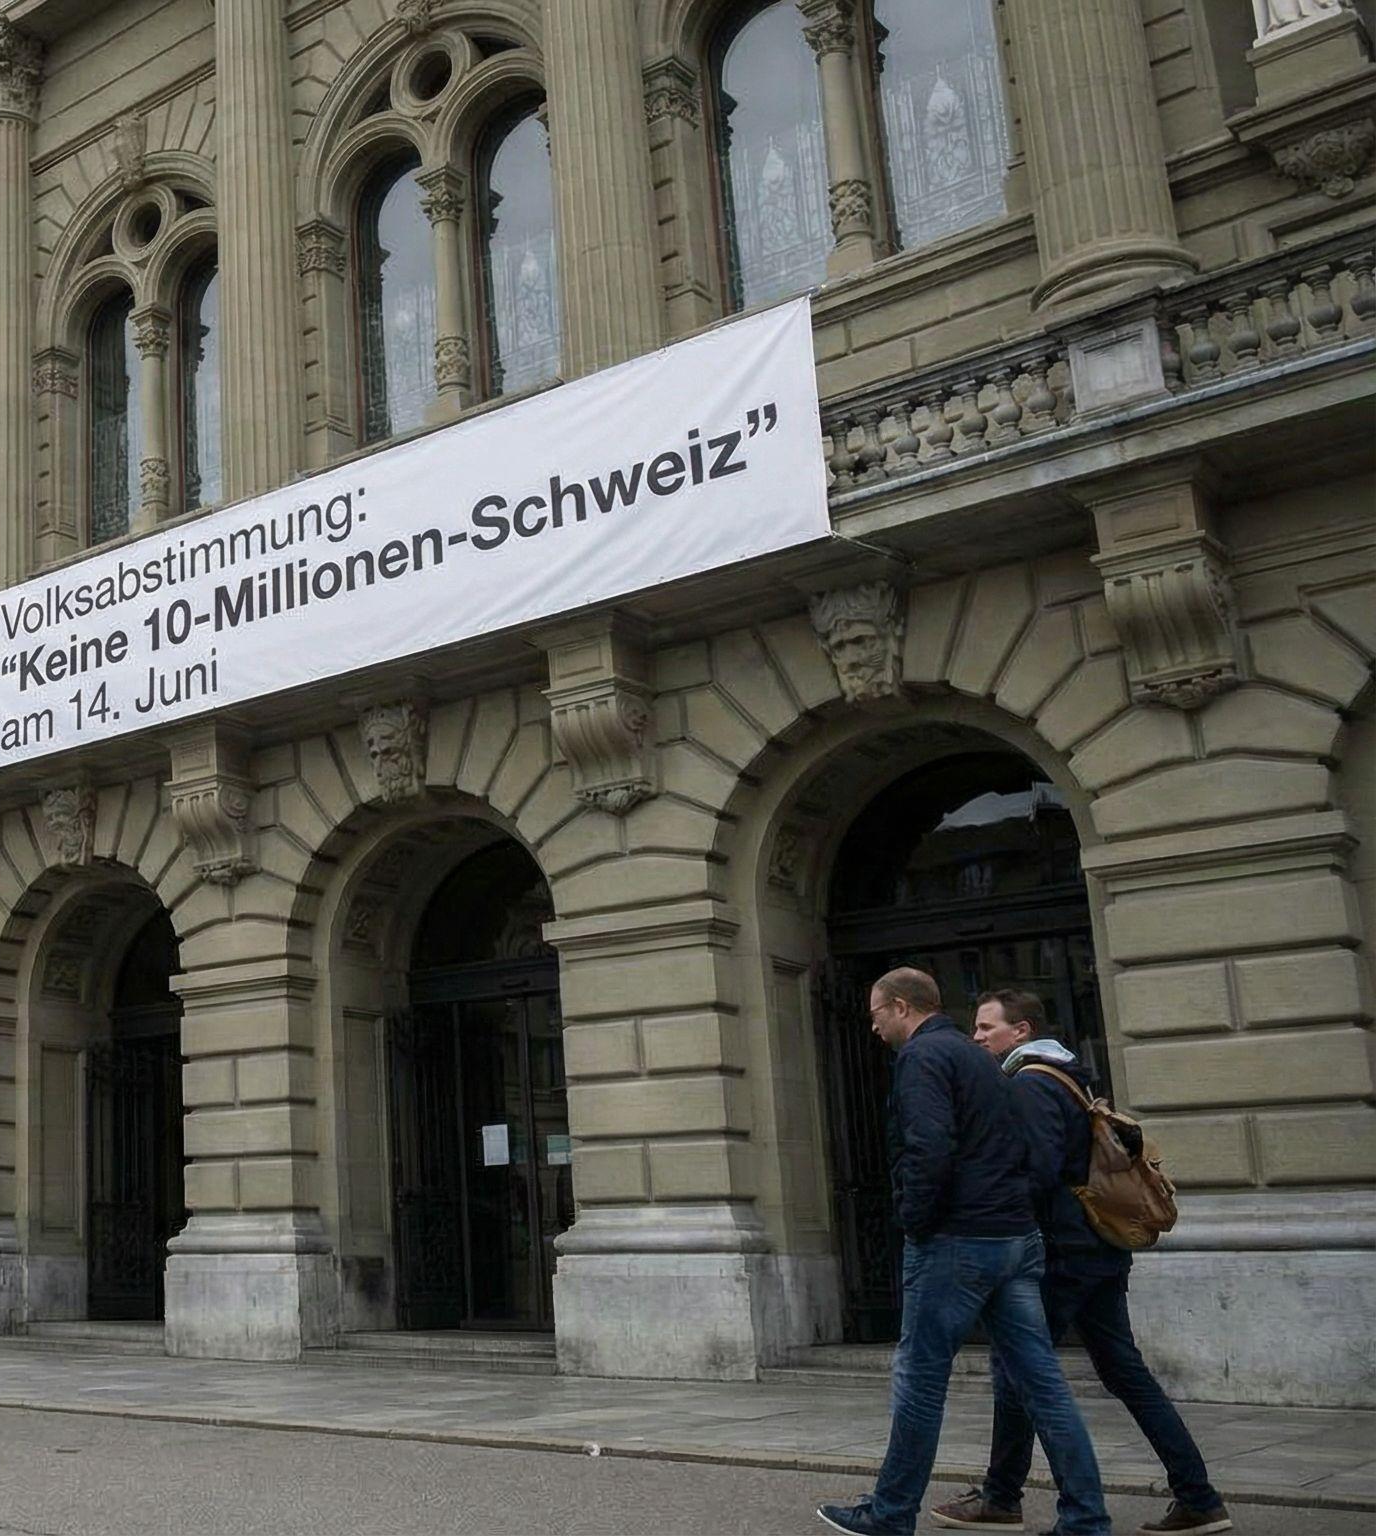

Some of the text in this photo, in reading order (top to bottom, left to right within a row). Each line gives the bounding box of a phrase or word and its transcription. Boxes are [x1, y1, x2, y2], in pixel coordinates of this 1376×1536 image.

[0, 484, 368, 641] Volksabstimmung:
[1, 402, 779, 692] “Keine 10-Millionen-Schweiz”
[0, 647, 218, 751] am 14. Juni
